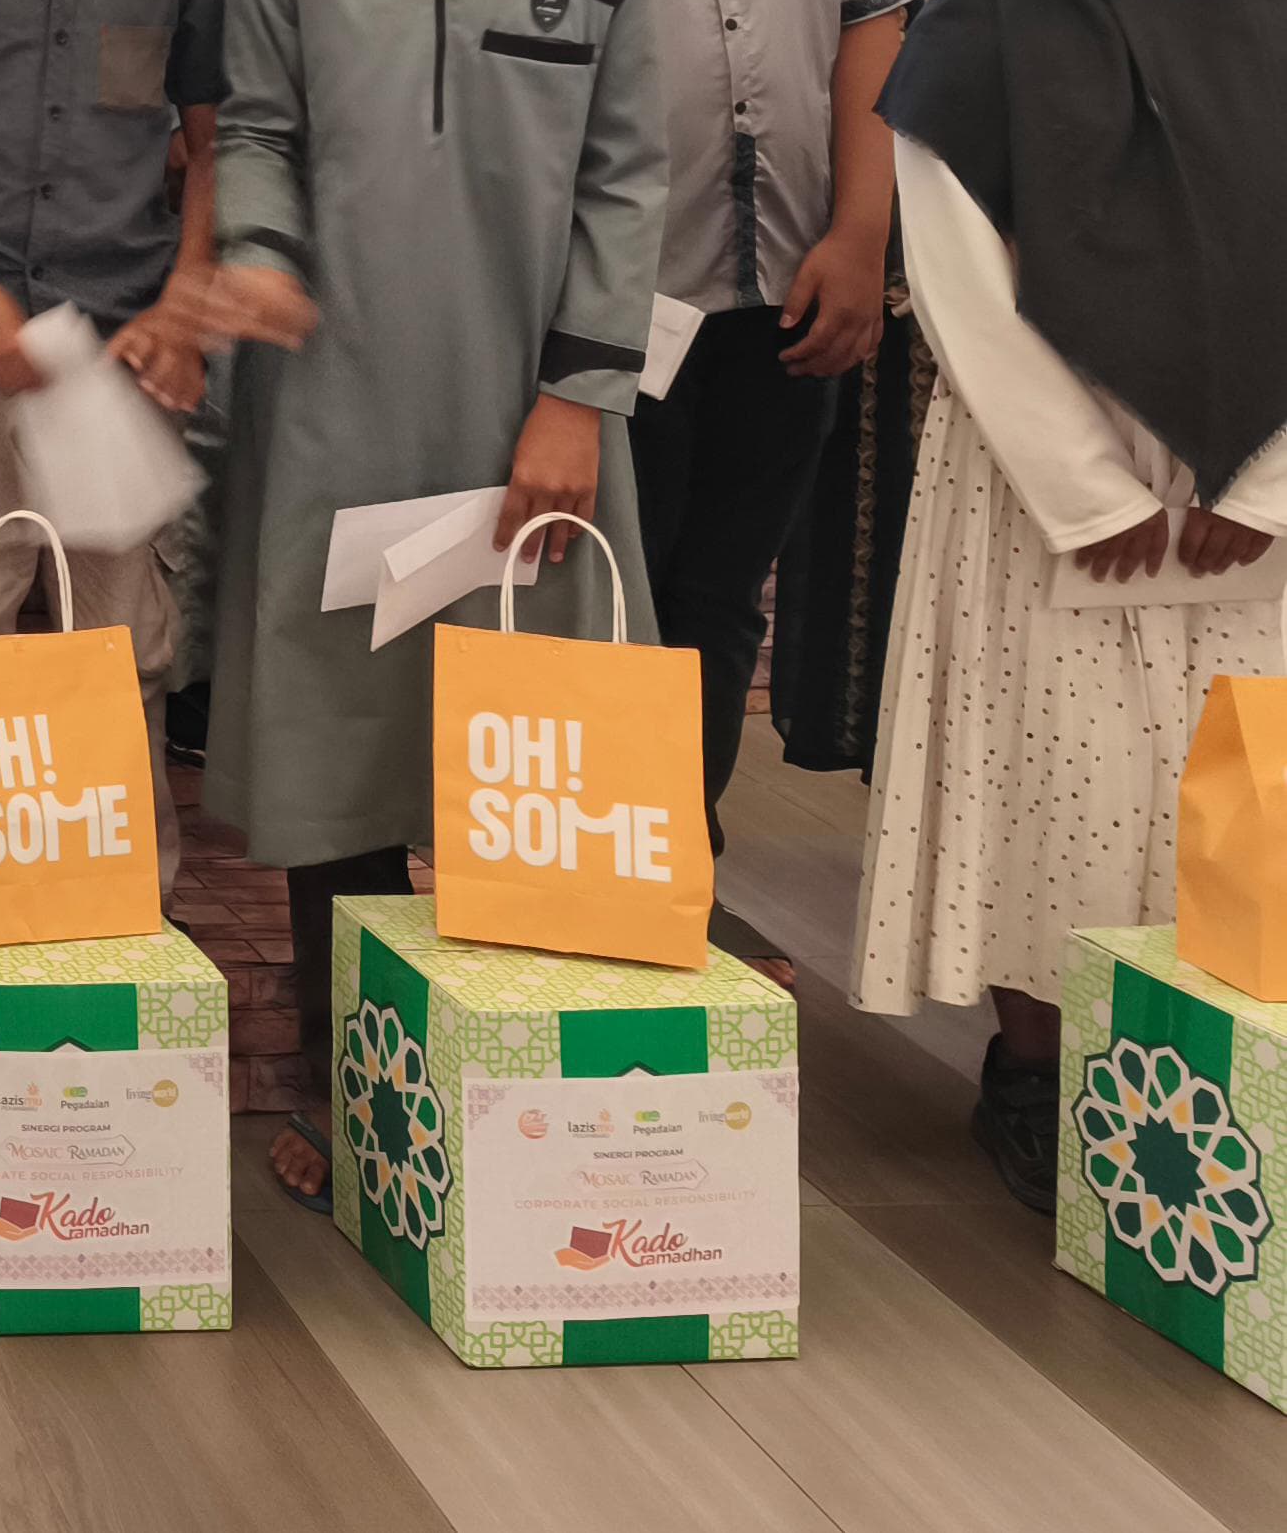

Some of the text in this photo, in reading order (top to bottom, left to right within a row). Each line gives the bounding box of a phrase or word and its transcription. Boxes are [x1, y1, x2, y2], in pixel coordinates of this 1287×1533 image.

[468, 711, 584, 793] OH!
[468, 787, 672, 883] SOME
[60, 1099, 110, 1110] Pegadaian
[22, 1123, 111, 1133] SINERGI PROGRAM
[30, 1171, 76, 1181] SOCIAL
[82, 1167, 184, 1181] RESPONSIBILITY
[30, 1191, 116, 1240] Kado
[68, 1221, 150, 1239] ramadhan
[603, 1219, 688, 1267] Kado
[640, 1248, 722, 1266] ramadhan
